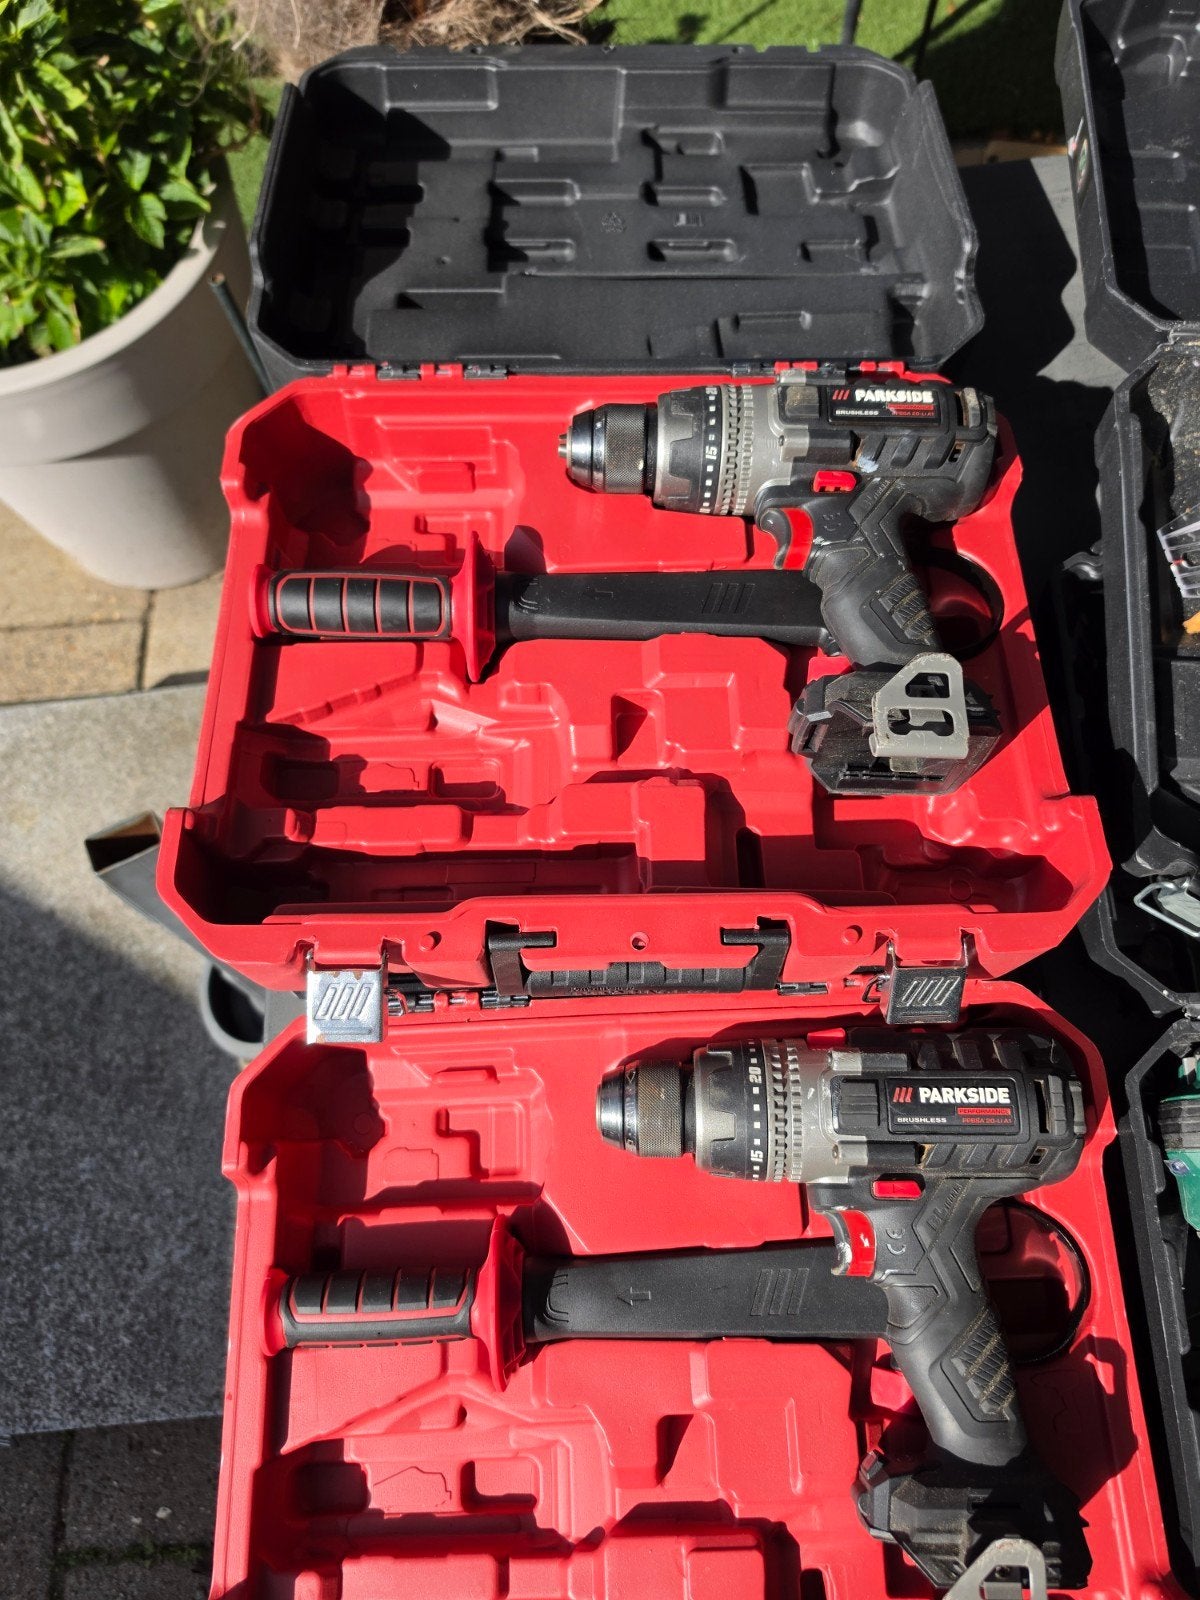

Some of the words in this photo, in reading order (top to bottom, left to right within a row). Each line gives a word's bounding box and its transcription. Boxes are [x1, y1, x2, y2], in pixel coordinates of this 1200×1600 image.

[855, 388, 934, 403] PARKSIDE
[705, 445, 718, 460] 15
[748, 1066, 762, 1083] 20
[919, 1087, 1011, 1104] PARKSIDE
[750, 1151, 764, 1163] 15
